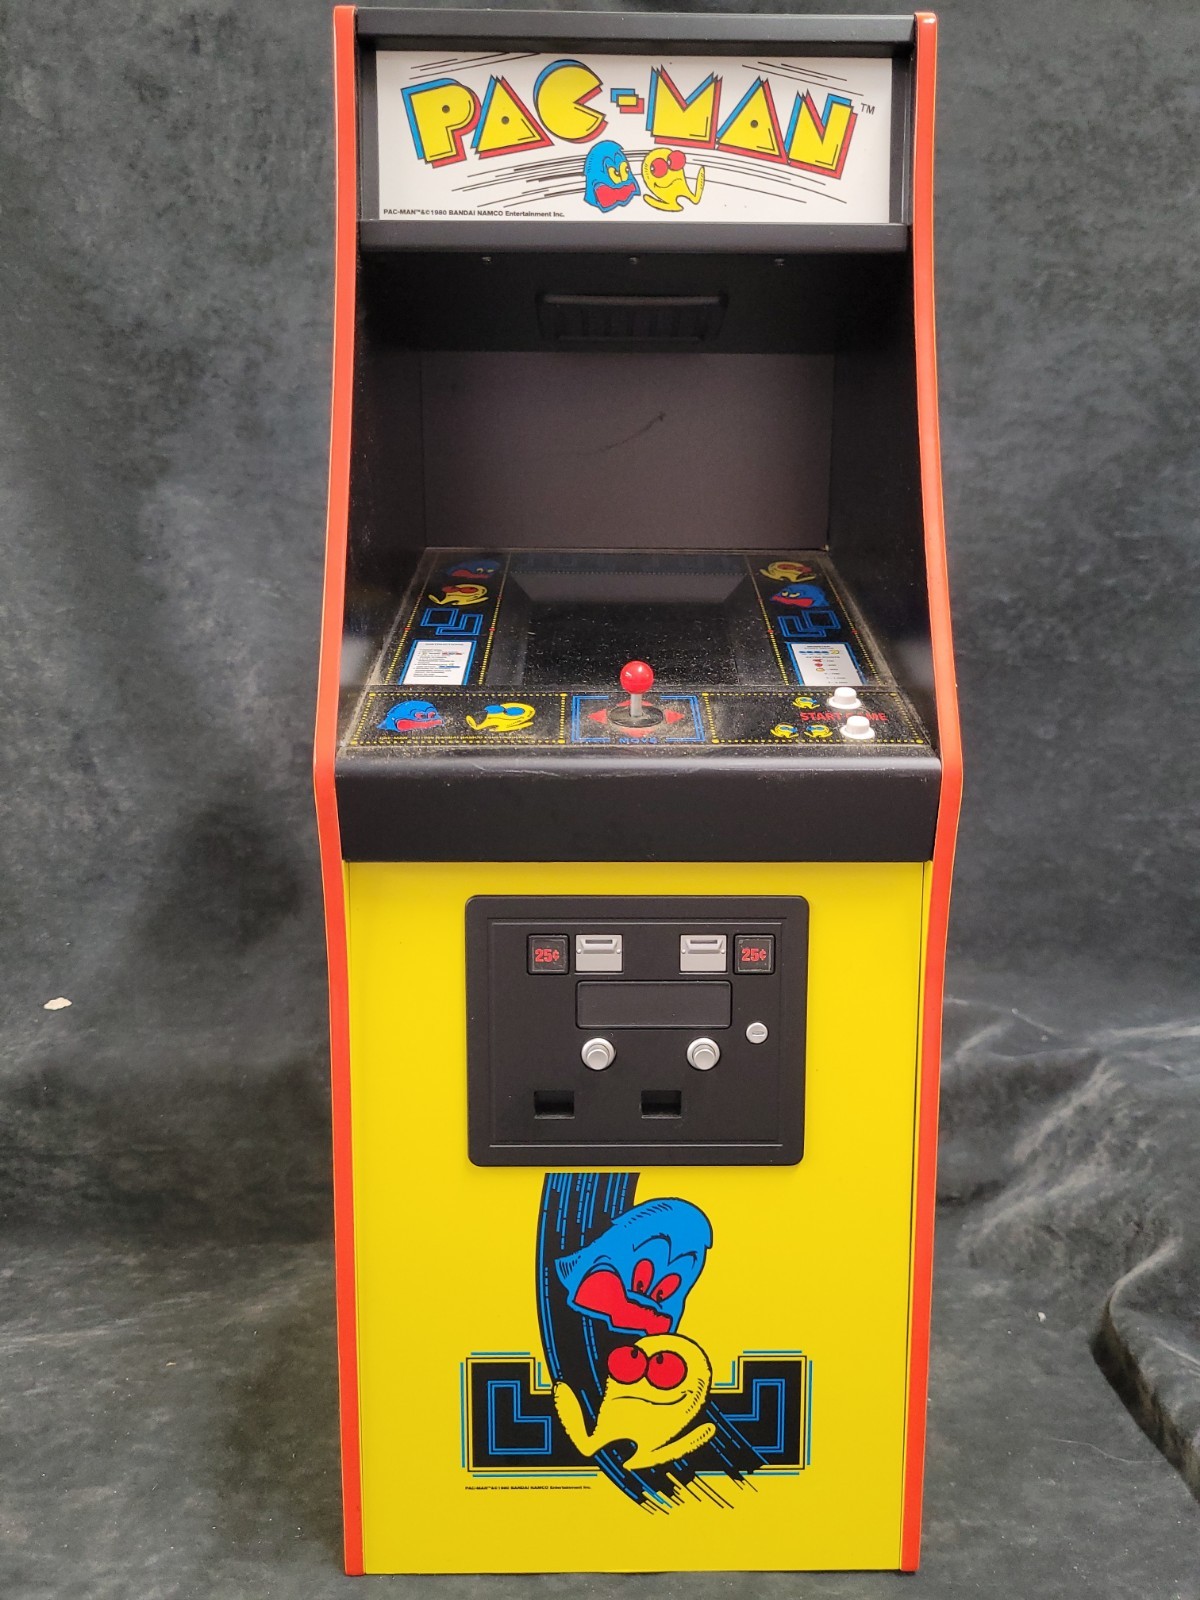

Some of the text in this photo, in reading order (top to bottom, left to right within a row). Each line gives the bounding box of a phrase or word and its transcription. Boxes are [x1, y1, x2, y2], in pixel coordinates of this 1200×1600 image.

[400, 58, 859, 180] PAC-MAN
[800, 712, 842, 722] START
[534, 948, 560, 963] 25¢
[741, 947, 767, 962] 25¢
